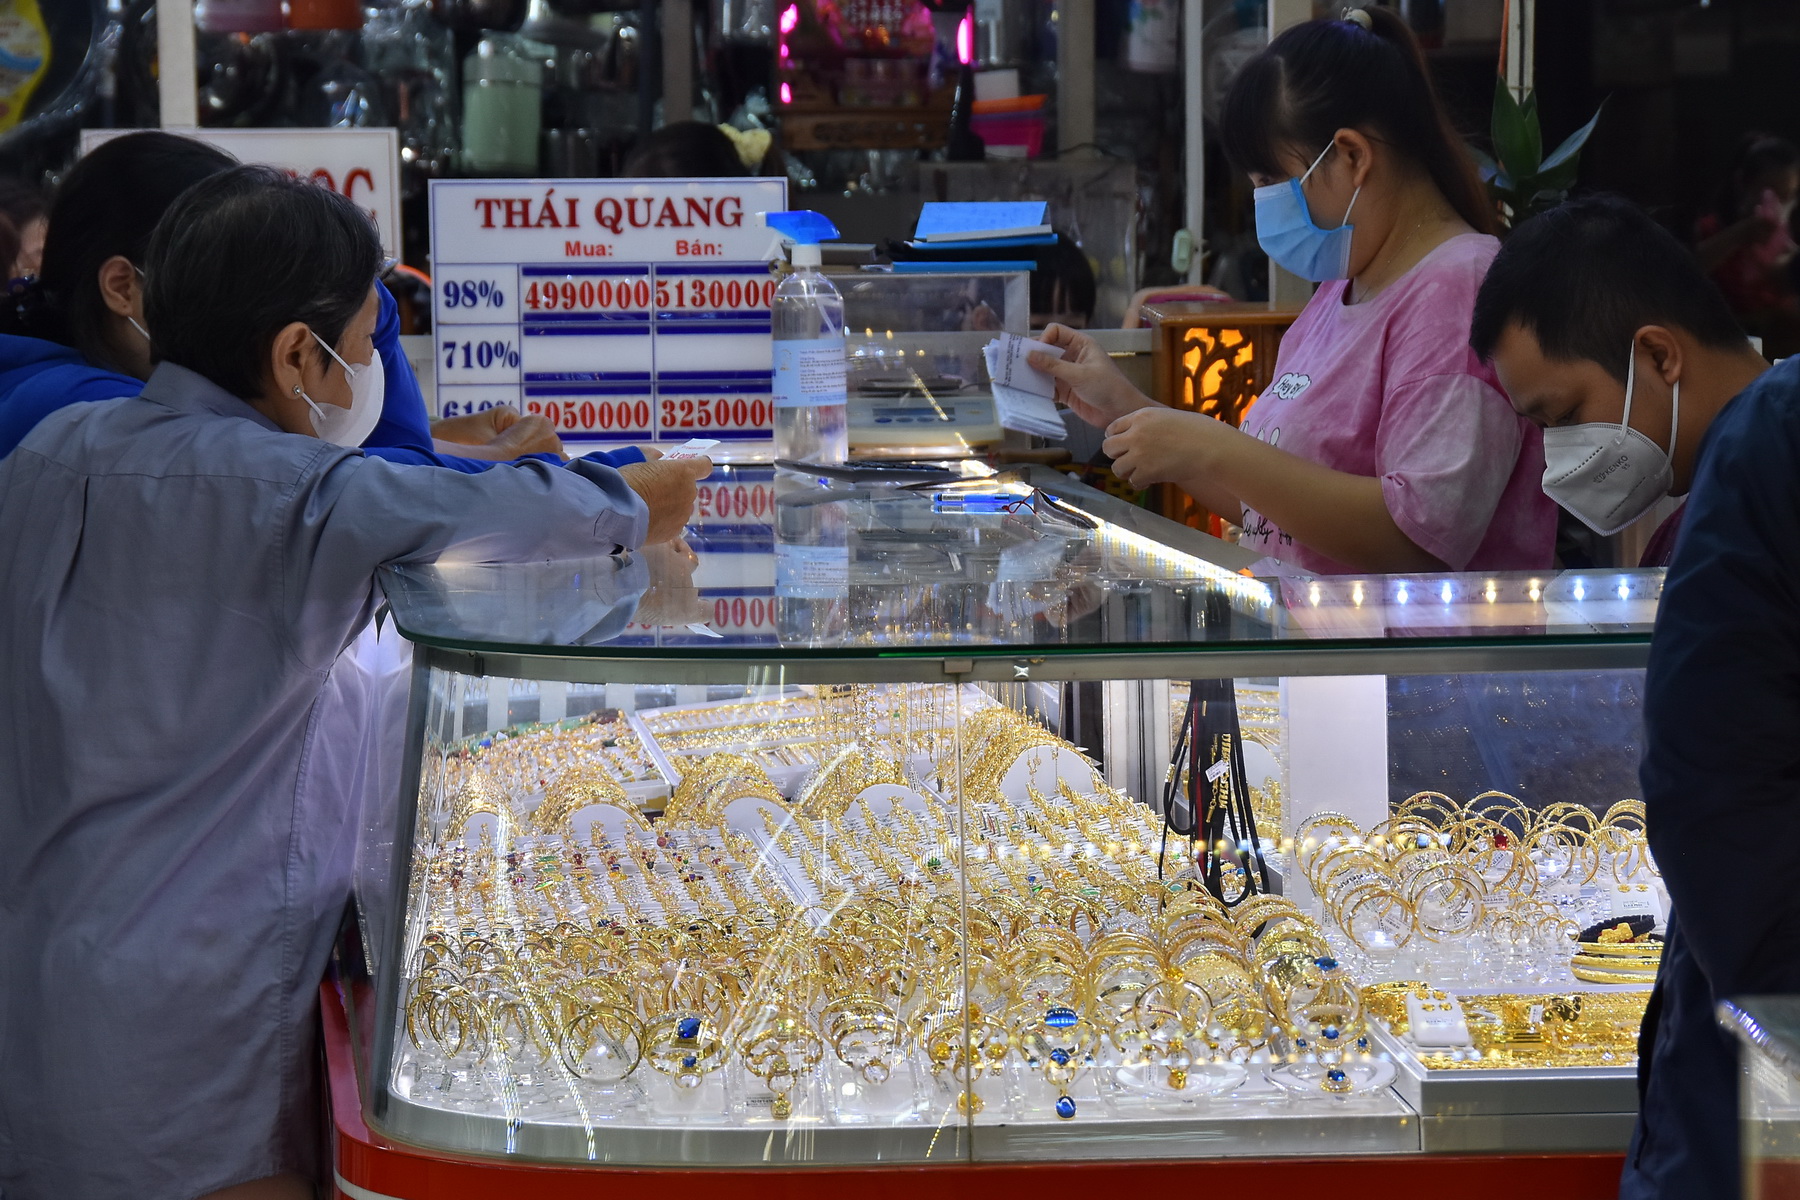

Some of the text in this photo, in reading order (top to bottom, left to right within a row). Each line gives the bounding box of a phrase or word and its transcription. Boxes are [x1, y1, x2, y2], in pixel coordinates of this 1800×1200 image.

[474, 187, 744, 235] THÁI QUANG
[564, 238, 722, 257] Mua: Bán:
[442, 279, 504, 308] 98%
[525, 279, 650, 310] 4990000
[442, 340, 520, 369] 710%
[1605, 455, 1628, 475] KENKO
